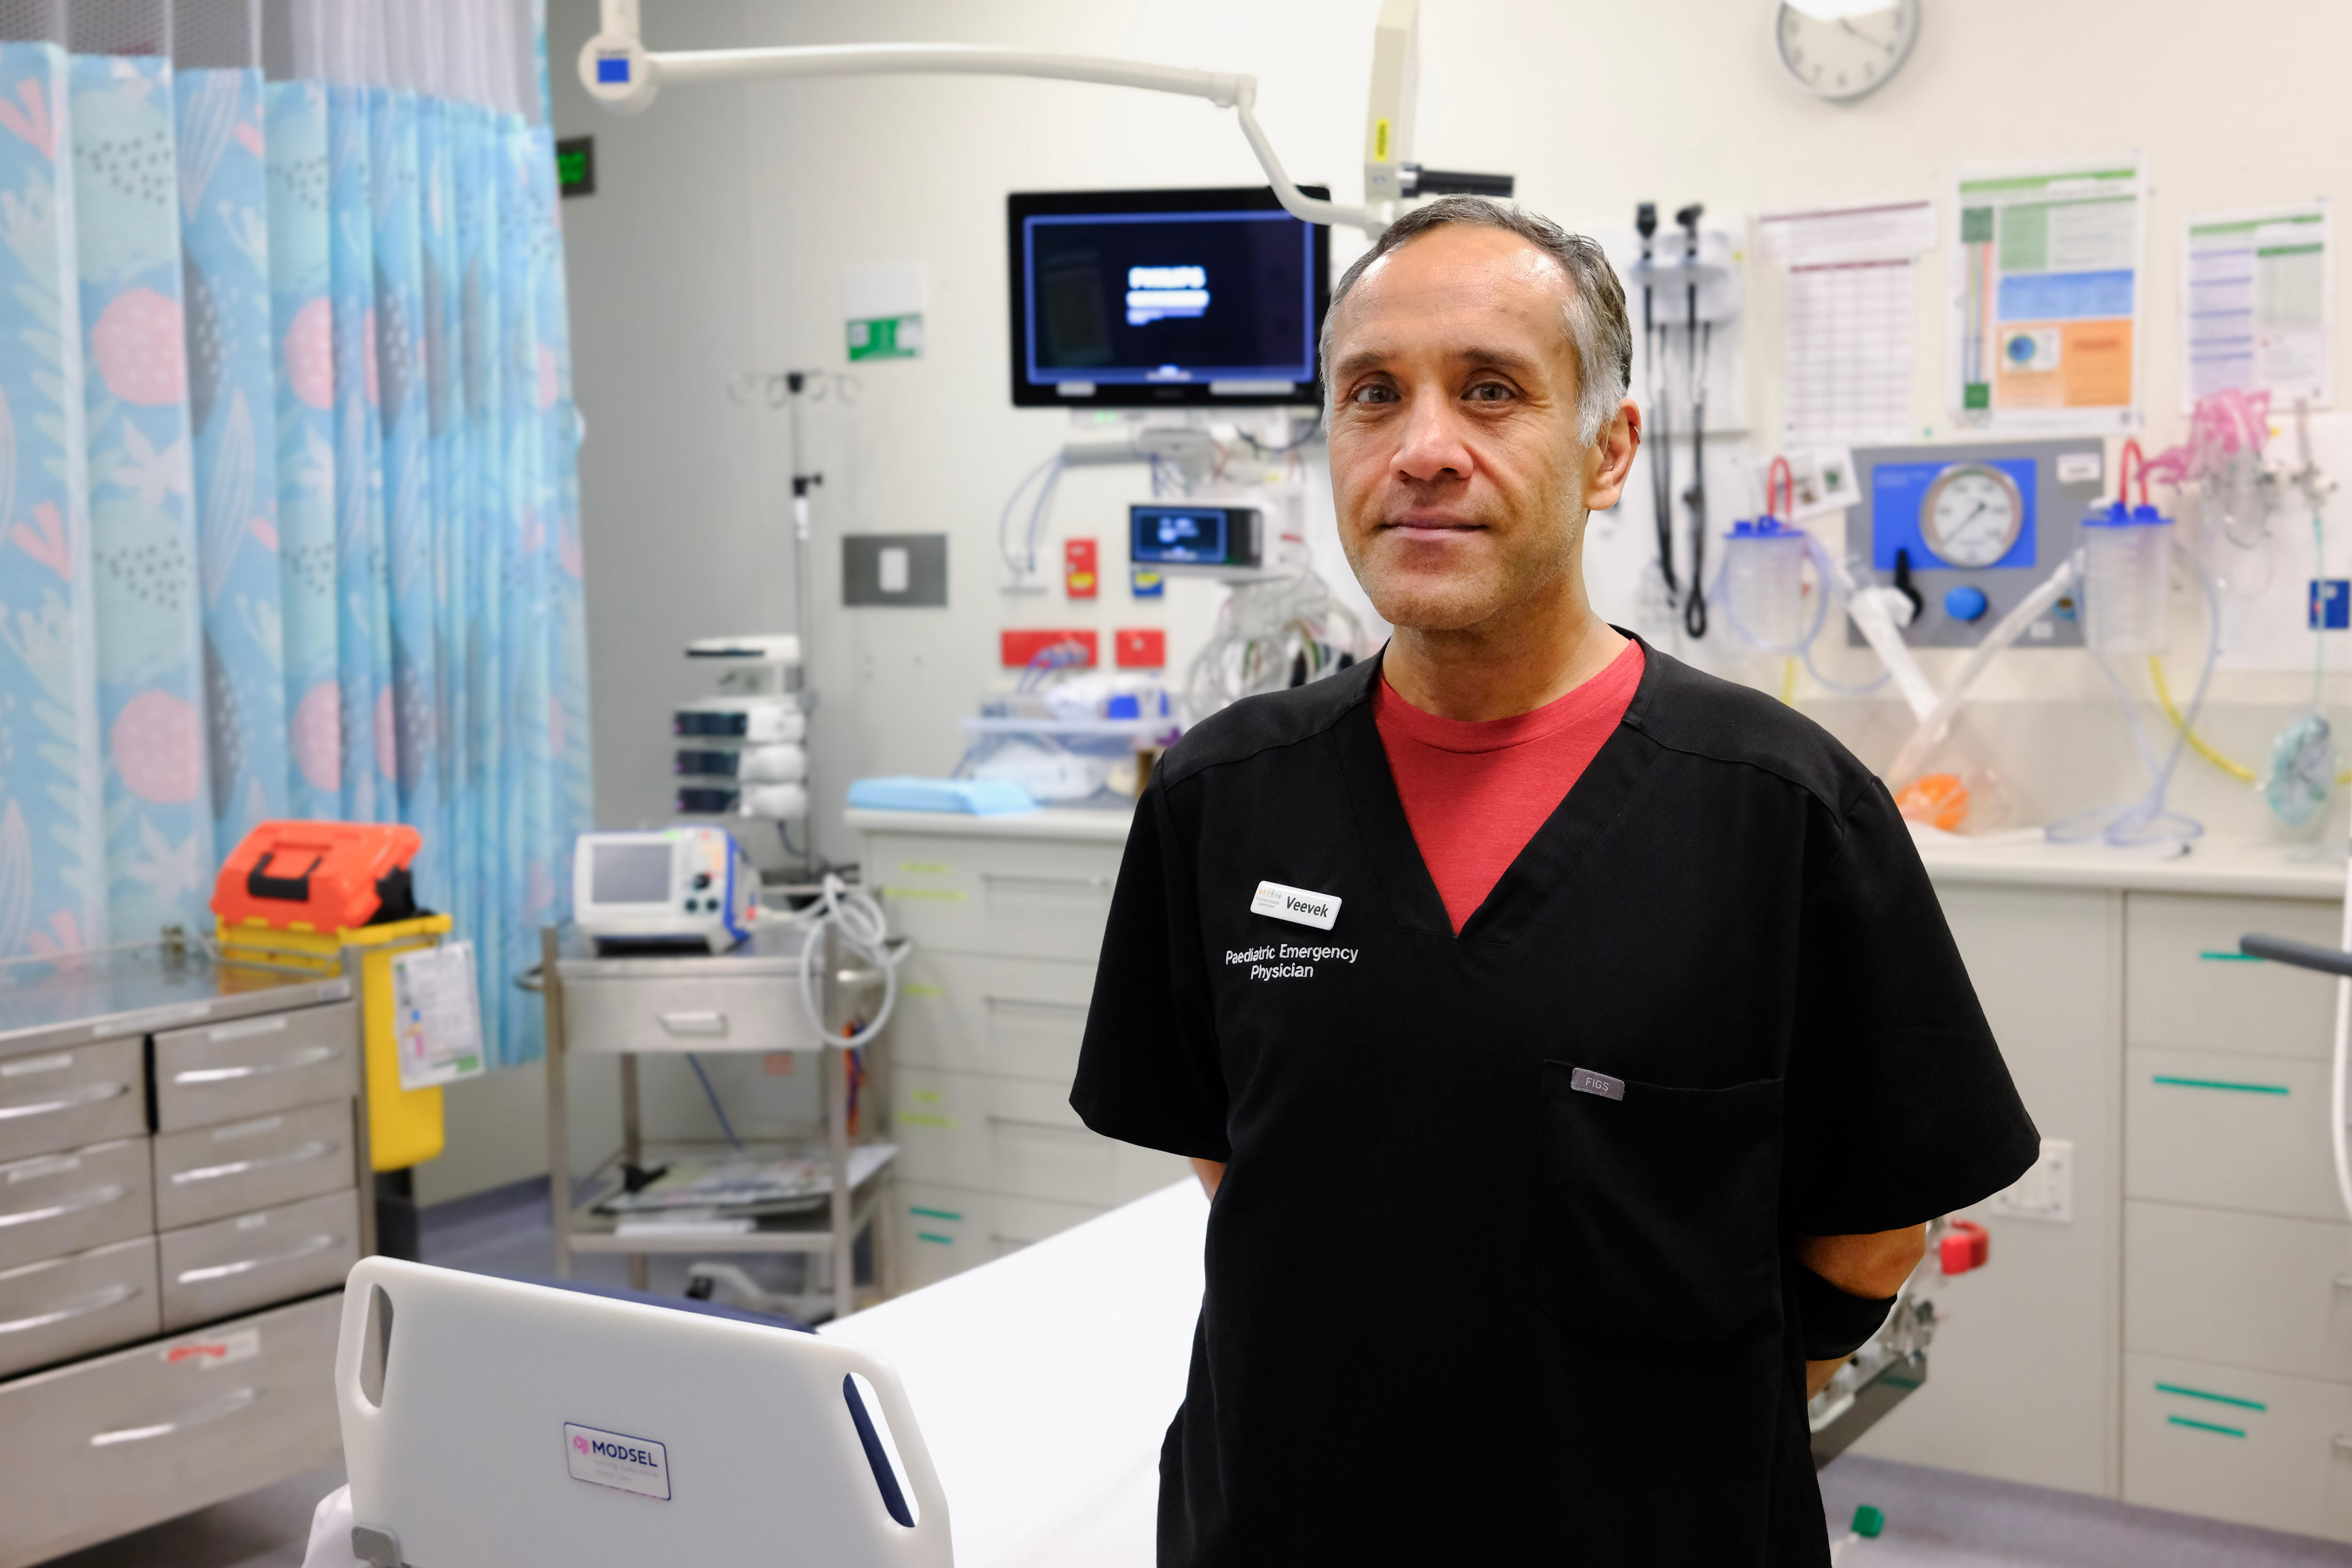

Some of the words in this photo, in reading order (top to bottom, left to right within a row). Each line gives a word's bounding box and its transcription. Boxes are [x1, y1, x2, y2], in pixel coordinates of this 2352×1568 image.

[1287, 896, 1328, 917] Veevek
[1225, 945, 1275, 964] Paediatric
[1279, 943, 1359, 963] Emergency
[1250, 963, 1314, 981] Physician
[1585, 1077, 1609, 1091] FIGS
[592, 1440, 658, 1467] MODSEL
